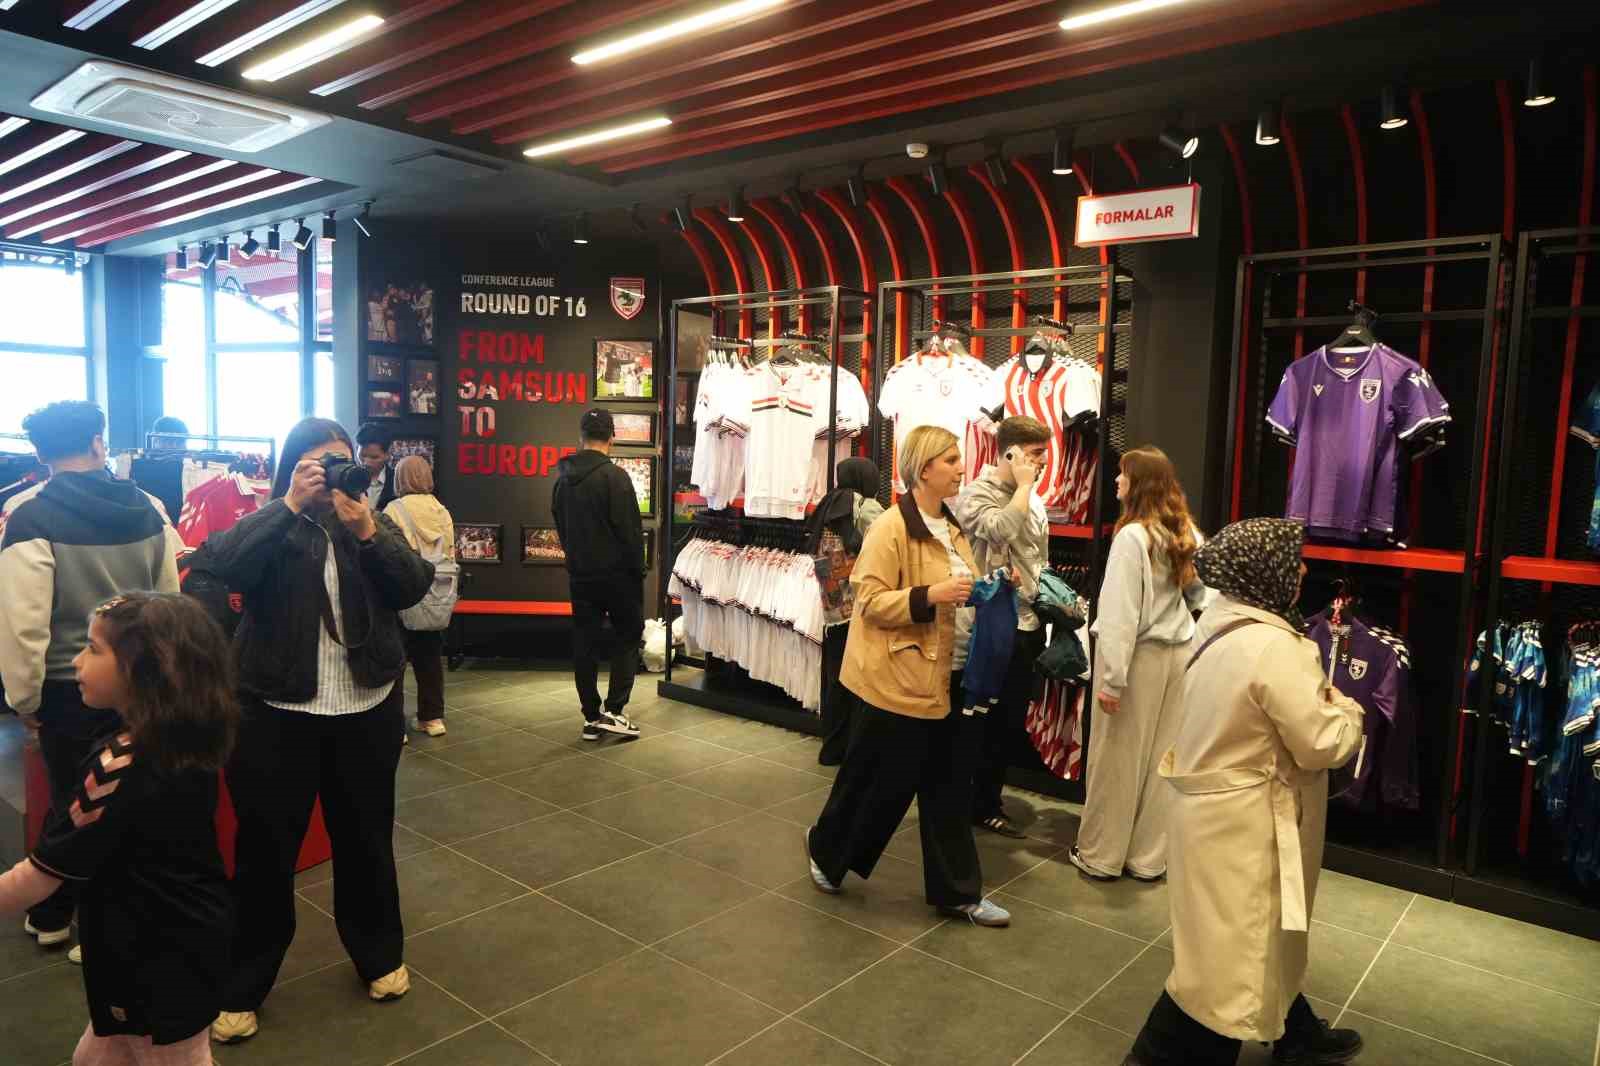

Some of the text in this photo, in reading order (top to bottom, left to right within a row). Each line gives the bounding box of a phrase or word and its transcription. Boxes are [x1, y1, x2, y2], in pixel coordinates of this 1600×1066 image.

[1095, 205, 1174, 225] FORMALAR
[461, 274, 555, 288] CONFERENCE LEAGUE
[461, 292, 587, 318] ROUND OF 16
[459, 330, 545, 365] FROM
[457, 368, 588, 404] SAMSUN
[457, 405, 496, 437] TO
